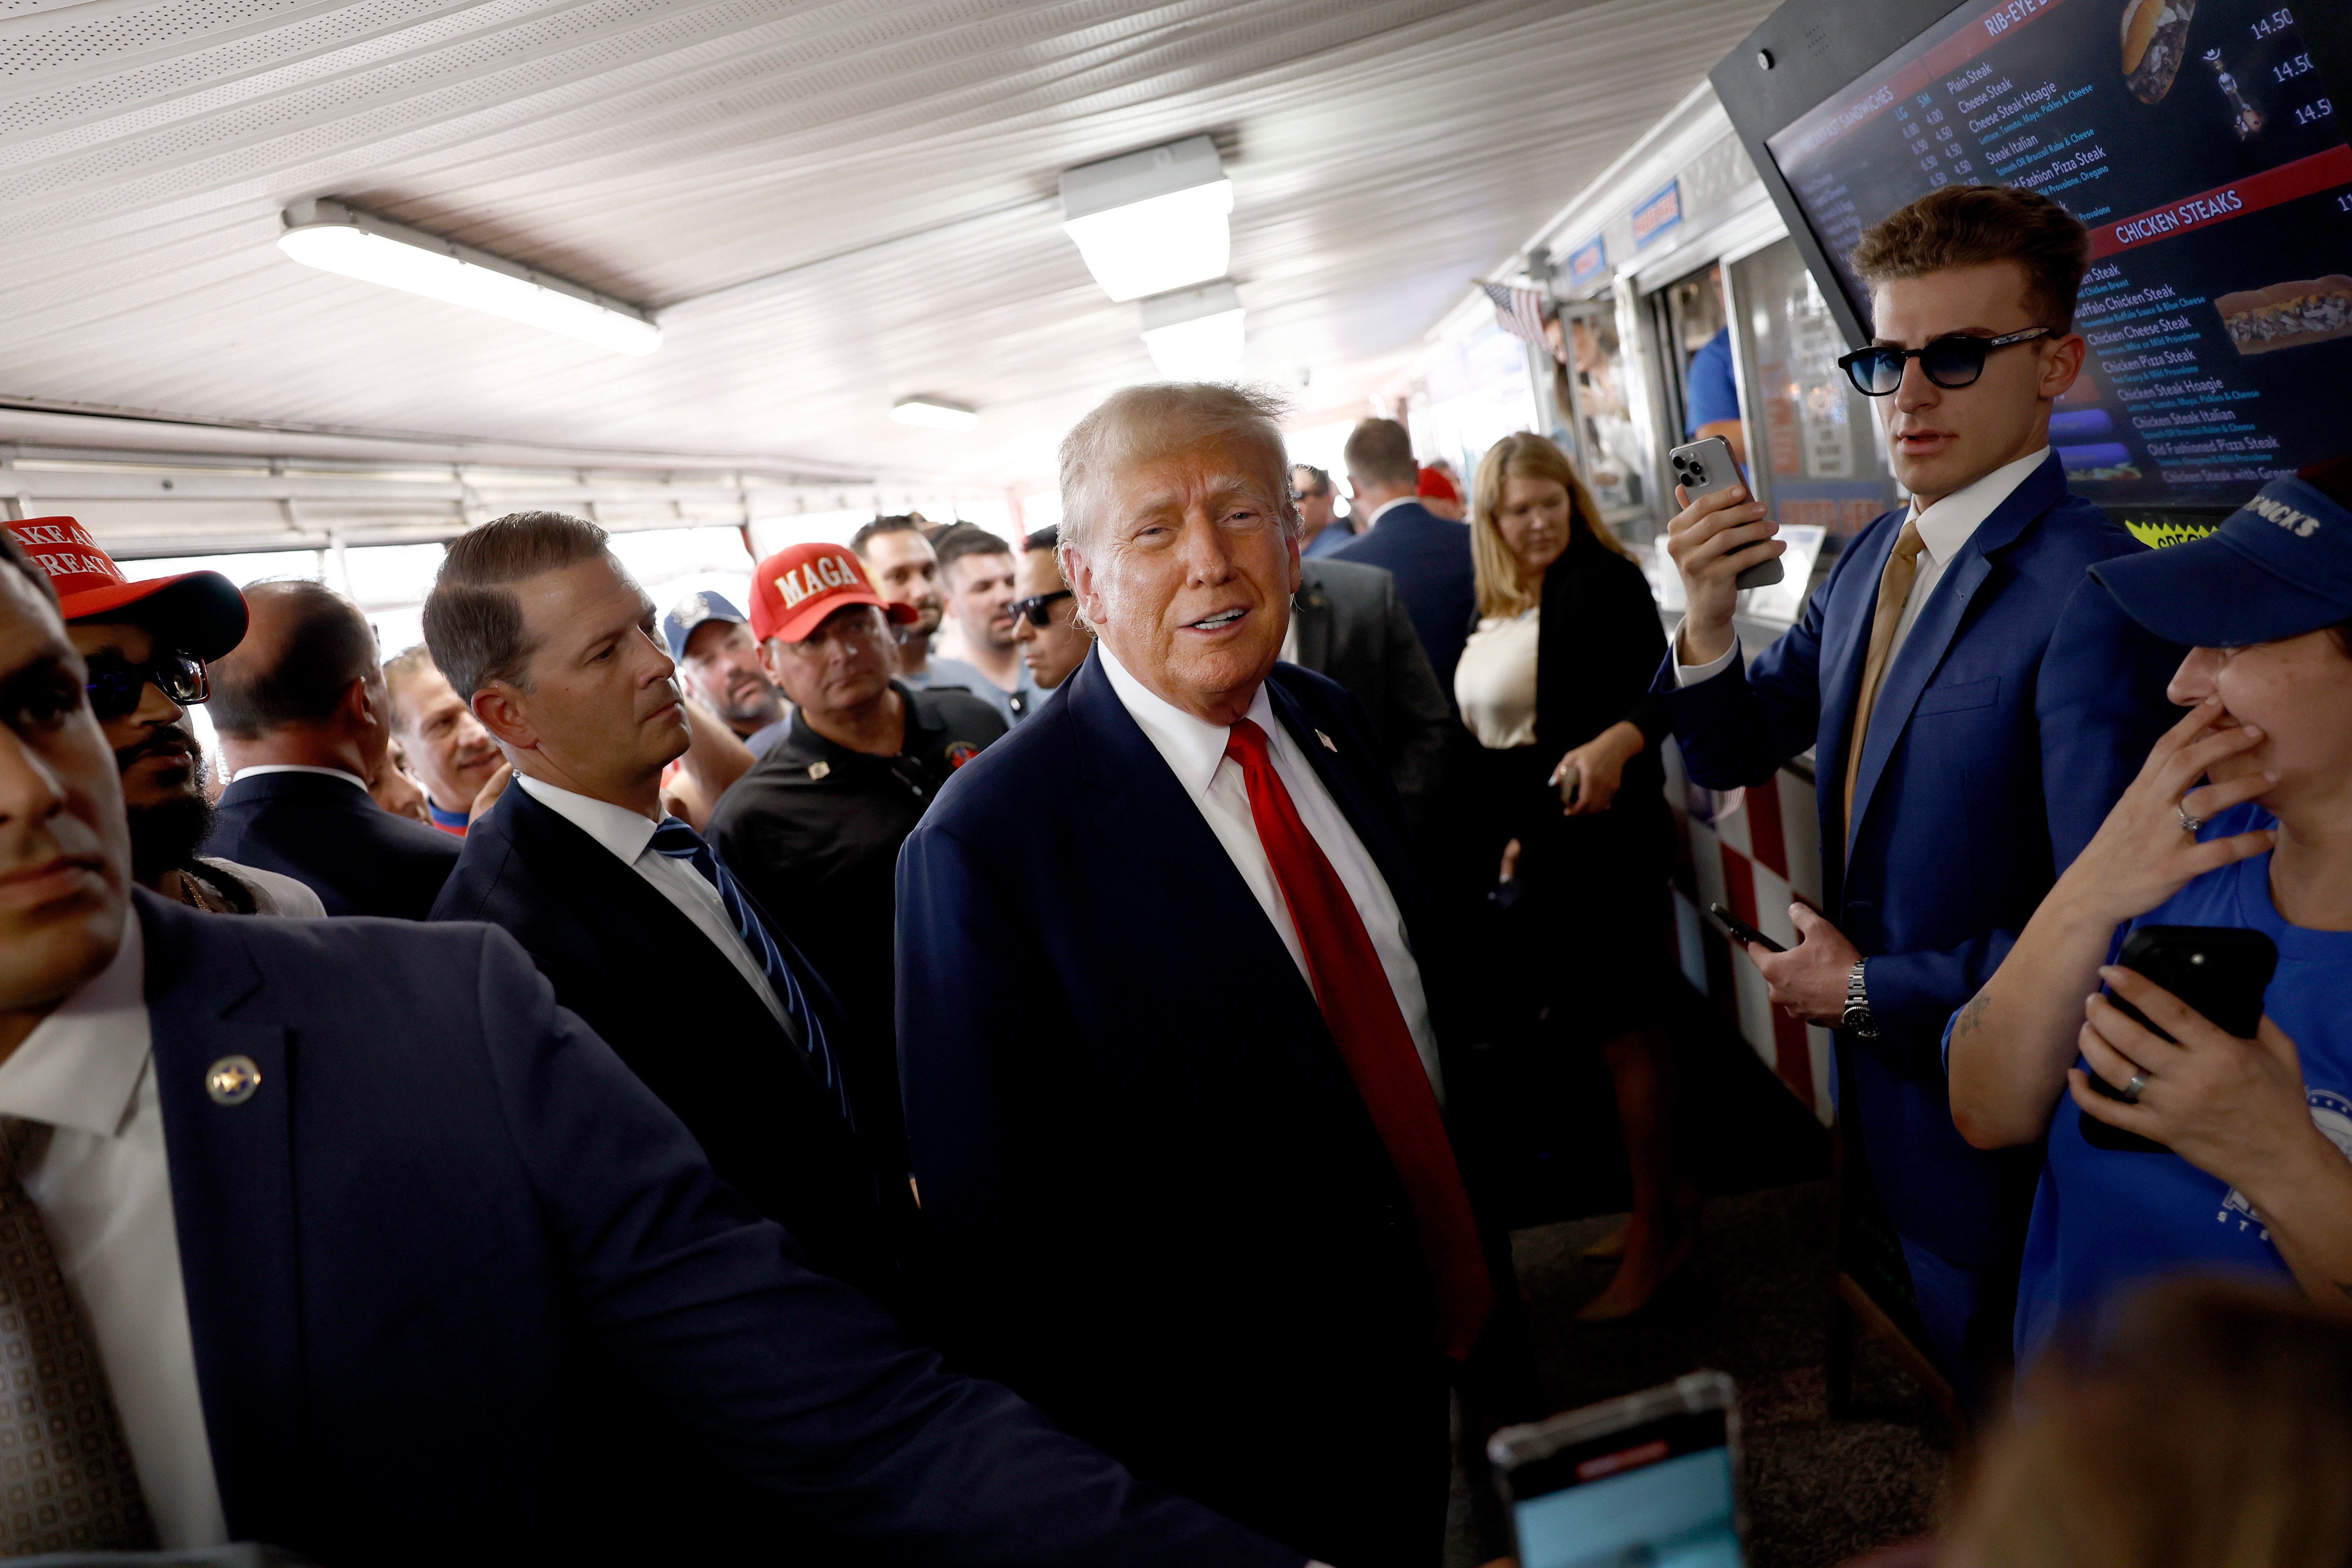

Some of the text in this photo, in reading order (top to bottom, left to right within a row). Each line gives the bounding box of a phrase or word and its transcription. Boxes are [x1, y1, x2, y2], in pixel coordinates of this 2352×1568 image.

[1984, 0, 2037, 37] RIB-EYE
[2251, 8, 2294, 40] 14.50
[1946, 62, 1993, 95] Plain Steak
[1894, 93, 1933, 121] LG SM
[1958, 77, 2013, 114] Cheese Steak
[1969, 81, 2057, 133] Cheese Steak Hoagie
[2022, 111, 2042, 125] Mayo,
[2040, 99, 2063, 115] Pickles
[2062, 94, 2069, 104] &
[2068, 83, 2094, 100] Cheese
[1926, 109, 1944, 125] 4.00
[2295, 97, 2333, 125] 14.5
[1936, 126, 1953, 142] 4.50
[2016, 158, 2027, 168] OR
[2048, 142, 2065, 156] Rabe
[2064, 138, 2072, 146] &
[2070, 128, 2095, 144] Cheese
[1945, 143, 1963, 159] 4.50
[1985, 134, 2039, 165] Steak Italian
[1954, 160, 1972, 176] 4.50
[2018, 169, 2054, 188] Fashion
[2051, 158, 2077, 176] Pizza
[2075, 144, 2107, 166] Steak
[2048, 176, 2081, 195] Provolone,
[2080, 165, 2109, 182] Oregano
[2078, 205, 2111, 221] Provolone
[2116, 189, 2243, 243] CHICKEN STEAKS
[2091, 263, 2122, 281] Steak
[2105, 294, 2145, 310] Chicken
[2143, 283, 2176, 301] Steak
[2161, 301, 2180, 311] Blue
[2179, 296, 2206, 307] Cheese
[2087, 315, 2192, 346] Chicken Cheese Steak
[2102, 347, 2196, 374] Chicken Pizza Steak
[2118, 376, 2224, 401] Chicken Steak Hoagie
[2132, 408, 2236, 429] Chicken Steak Italian
[2216, 438, 2245, 451] Pizza
[2244, 435, 2280, 449] Steak
[7, 525, 73, 545] AKE
[775, 555, 859, 610] MAGA
